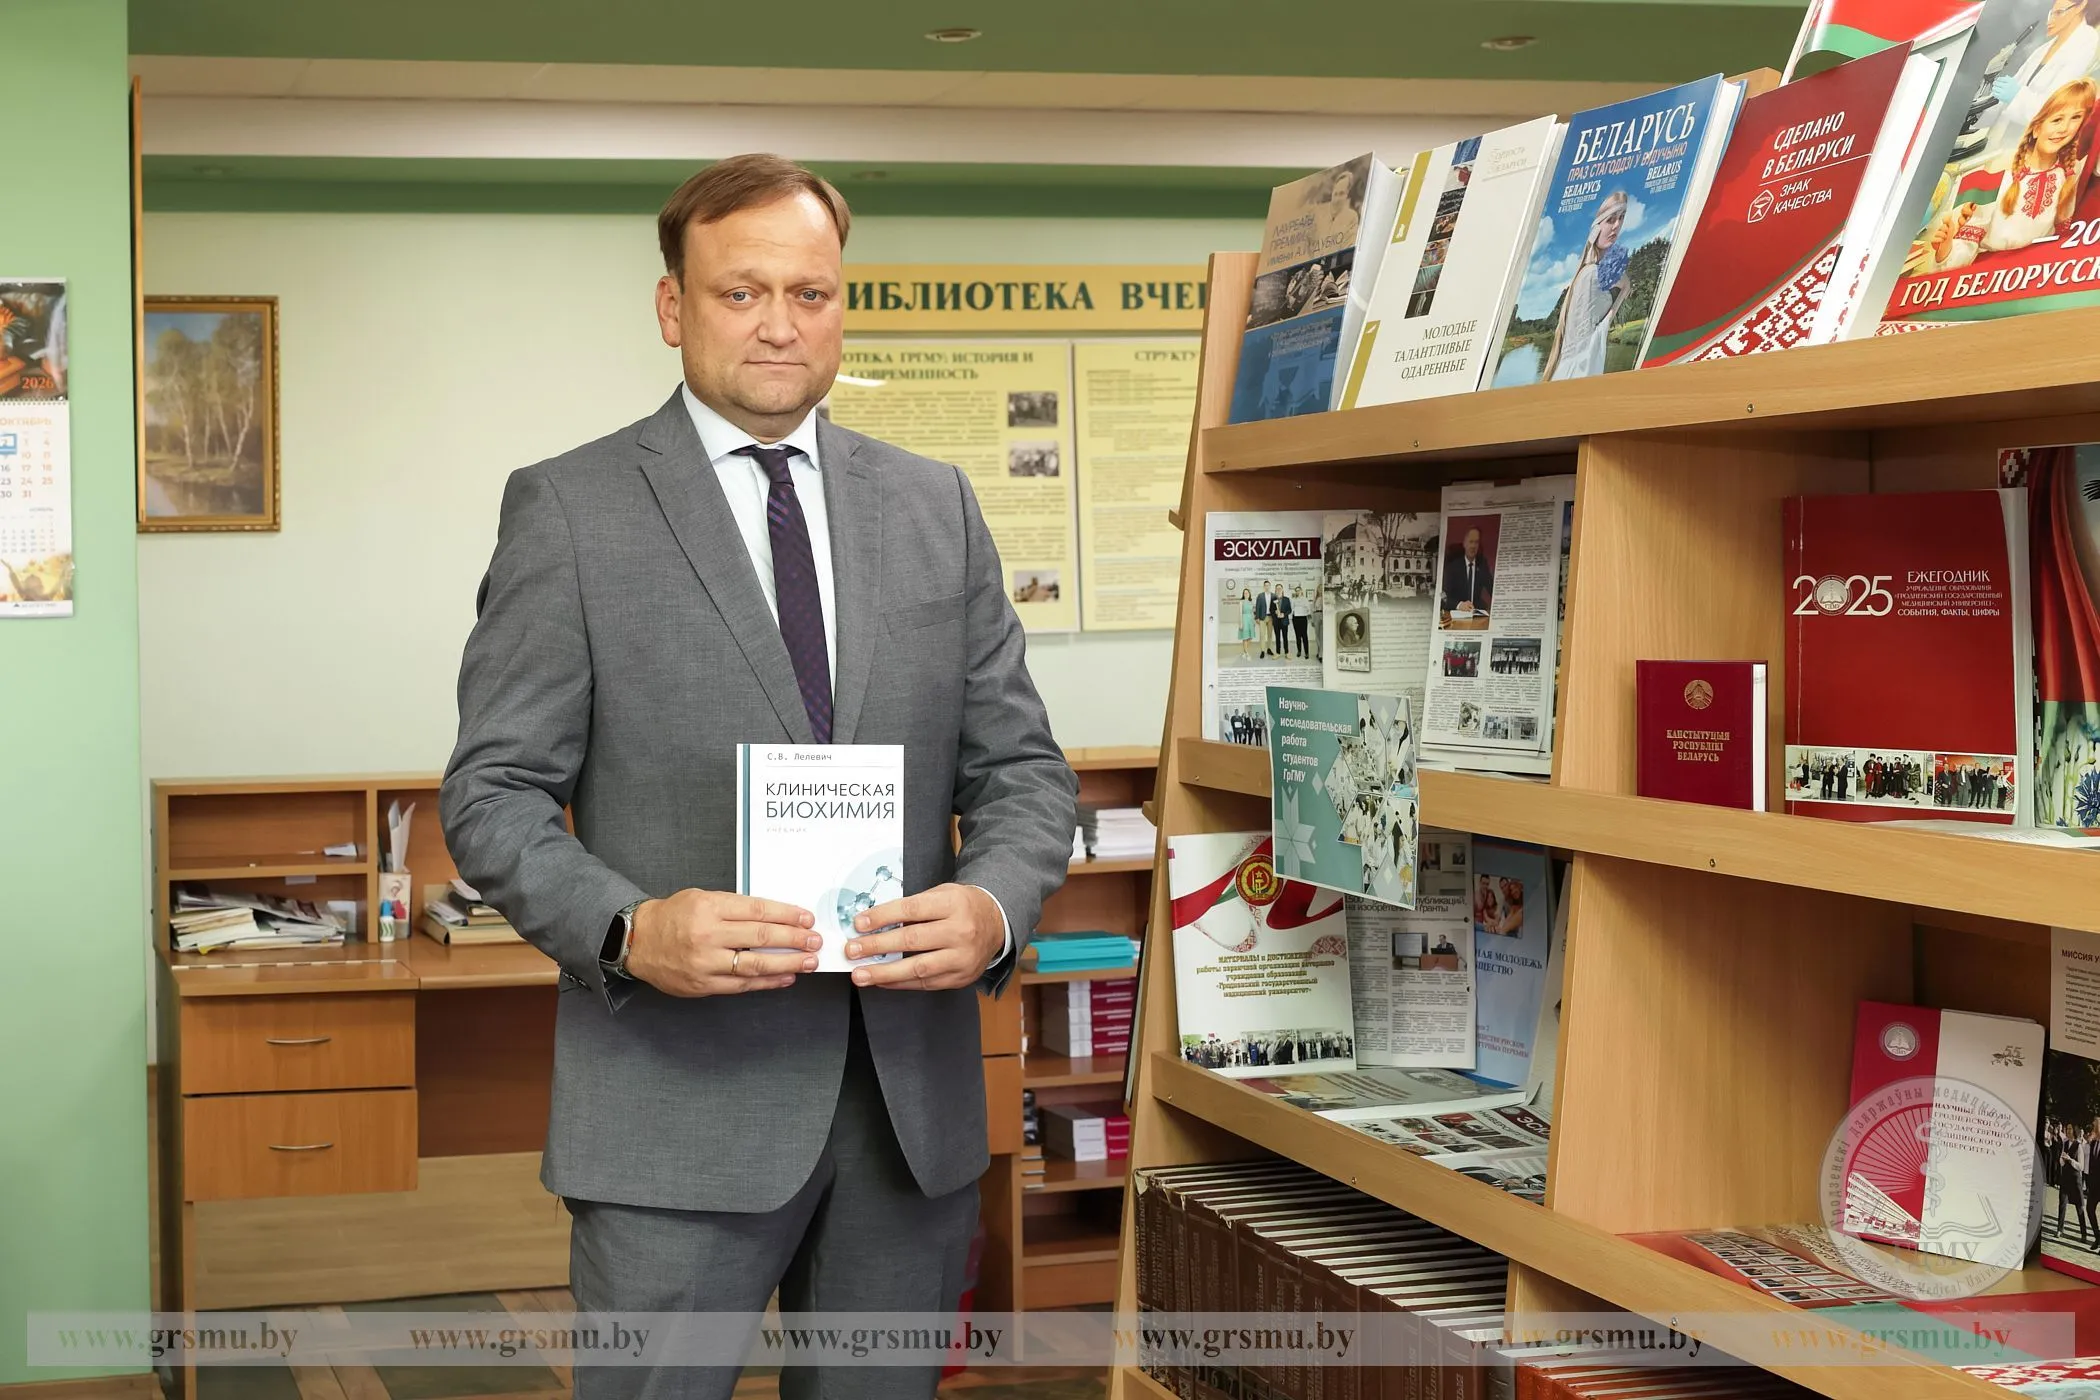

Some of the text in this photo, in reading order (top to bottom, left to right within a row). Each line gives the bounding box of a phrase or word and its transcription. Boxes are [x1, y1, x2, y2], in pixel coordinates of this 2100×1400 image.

[1572, 101, 1697, 166] БЕЛАРУСЬ
[1773, 111, 1845, 152] СДЕЛАНО
[1762, 134, 1856, 179] В БЕЛАРУСИ
[1567, 165, 1589, 182] ПРАЗ
[1646, 160, 1683, 181] BELARUS
[1562, 180, 1602, 199] БЕЛАРУСЬ
[1780, 178, 1813, 197] ЗНАК
[1773, 189, 1833, 214] КАЧЕСТВА
[1900, 277, 1952, 308] ГОД
[1422, 320, 1478, 341] МОЛОДЫЕ
[952, 352, 1019, 364] ИСТОРИЯ
[1022, 350, 1034, 363] И
[1393, 339, 1472, 363] ТАЛАНТЛИВЫЕ
[850, 369, 979, 380] СОВРЕМЕННОСТЬ
[1401, 358, 1468, 380] ОДАРЕННЫЕ
[1, 464, 11, 472] 16
[22, 464, 31, 472] 17
[21, 478, 33, 486] 24
[42, 478, 53, 486] 25
[0, 490, 32, 498] 30 31
[1222, 540, 1311, 558] ЭСКУЛАП
[1907, 570, 1991, 583] ЕЖЕГОДНИК
[1897, 608, 2000, 617] СОБЫТИЯ, ФАКТЫ, ЦИФРЫ
[1278, 696, 1309, 712] Научно-
[1280, 717, 1352, 734] исследовательская
[1281, 733, 1307, 748] работа
[1666, 729, 1730, 740] КАНСТЫТУЦЫЯ
[1672, 740, 1724, 751] РЭСПУБЛІКІ
[767, 752, 832, 761] С.В. Лелевич
[1282, 753, 1319, 767] студентов
[1677, 751, 1719, 762] БЕЛАРУСЬ
[1283, 768, 1306, 783] ГрГМУ
[766, 782, 895, 797] КЛИНИЧЕСКАЯ
[766, 801, 895, 819] БИОХИМИЯ
[1419, 904, 1449, 913] гранты
[1218, 954, 1260, 964] МАТЕРИАЛЫ
[1495, 952, 1543, 969] МОЛОДЕЖЬ
[2061, 949, 2094, 961] МИССИЯ
[1196, 965, 1221, 974] работы
[1934, 1102, 1974, 1115] НАУЧНЫЕ
[1934, 1111, 2000, 1128] ГРОДНЕНСКОГО
